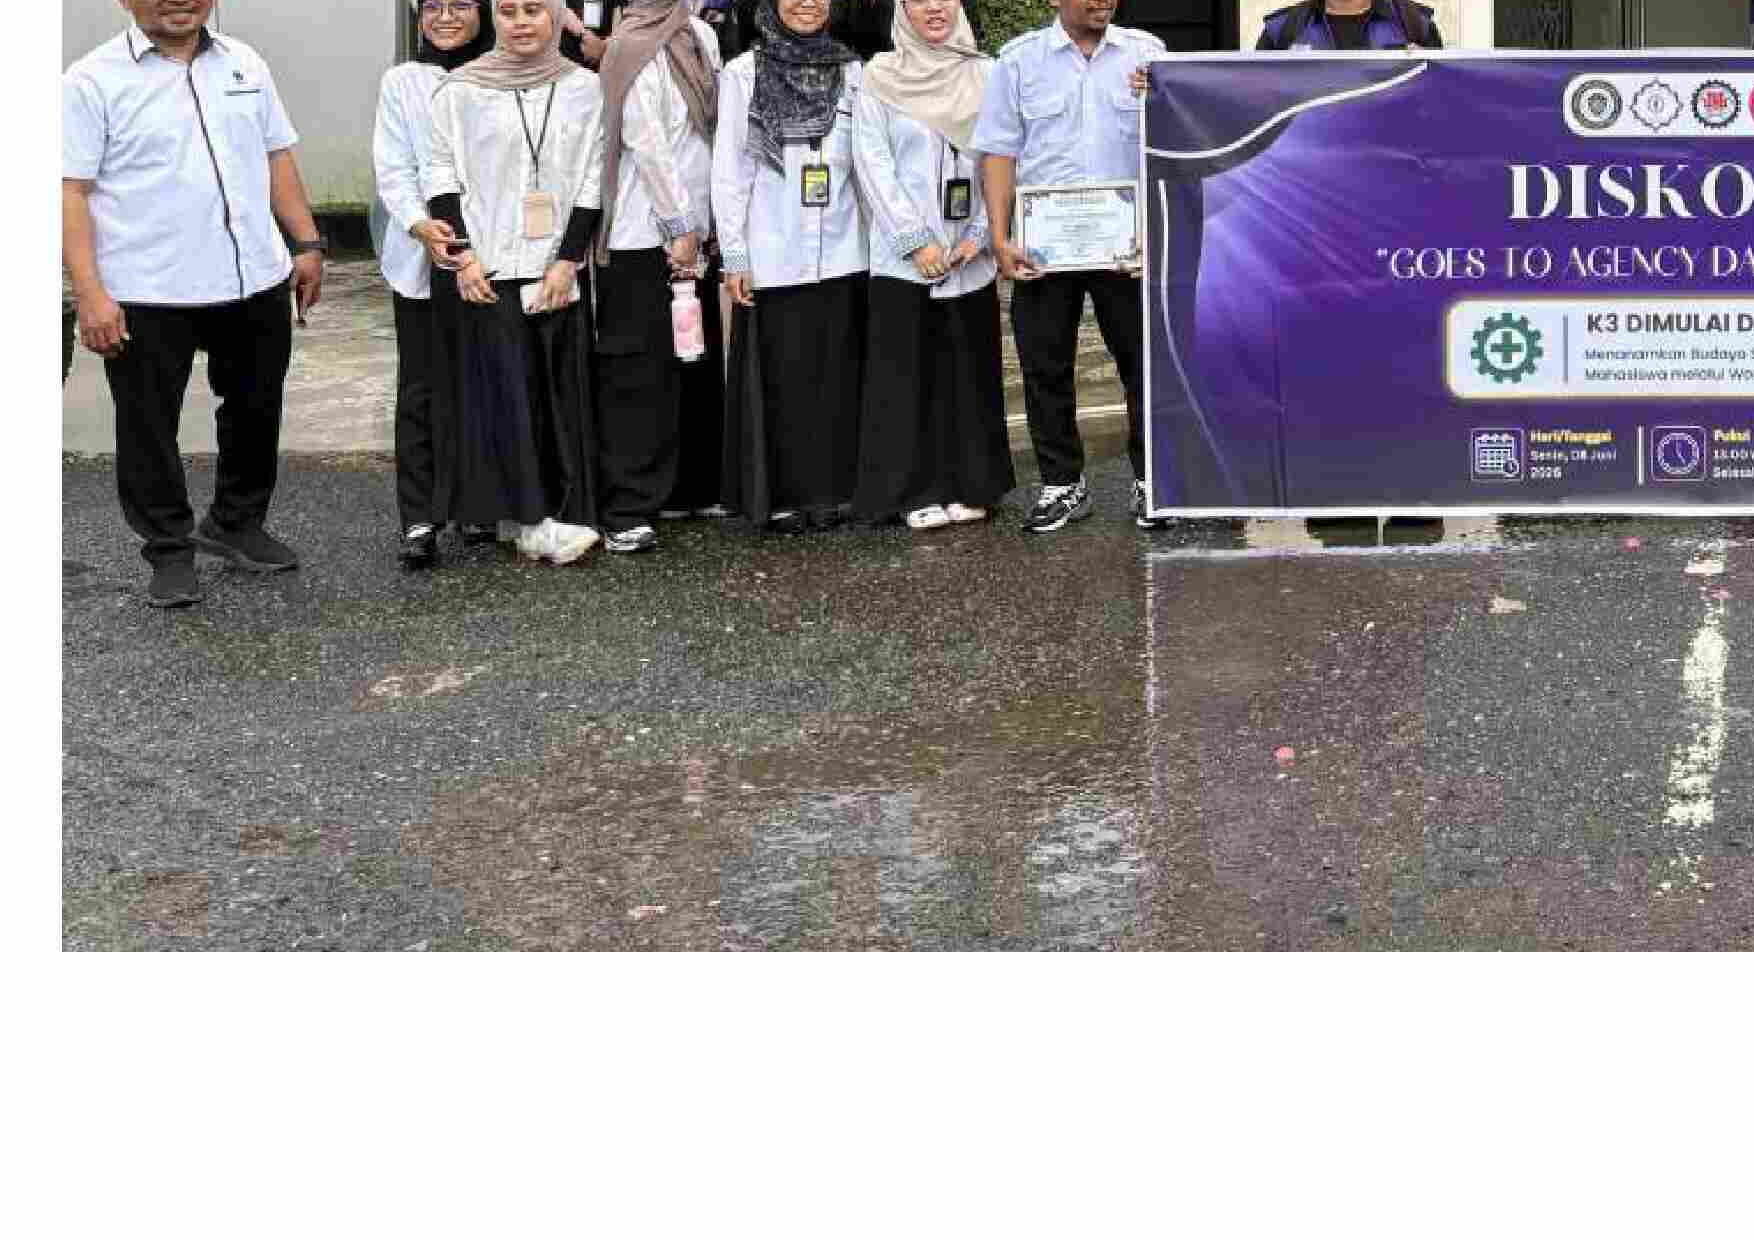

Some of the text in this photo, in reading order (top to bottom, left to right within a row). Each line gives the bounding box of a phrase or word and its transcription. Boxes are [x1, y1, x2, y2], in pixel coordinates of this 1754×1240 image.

[1504, 245, 1552, 279] TO
[1568, 245, 1696, 279] AGENCY
[1587, 312, 1619, 333] K3
[1626, 312, 1730, 333] DIMULAI
[1584, 346, 1686, 360] Menanamkan
[1691, 346, 1746, 362] Budaya
[1584, 367, 1667, 381] Mahasiswa
[1713, 428, 1752, 442] Pukul
